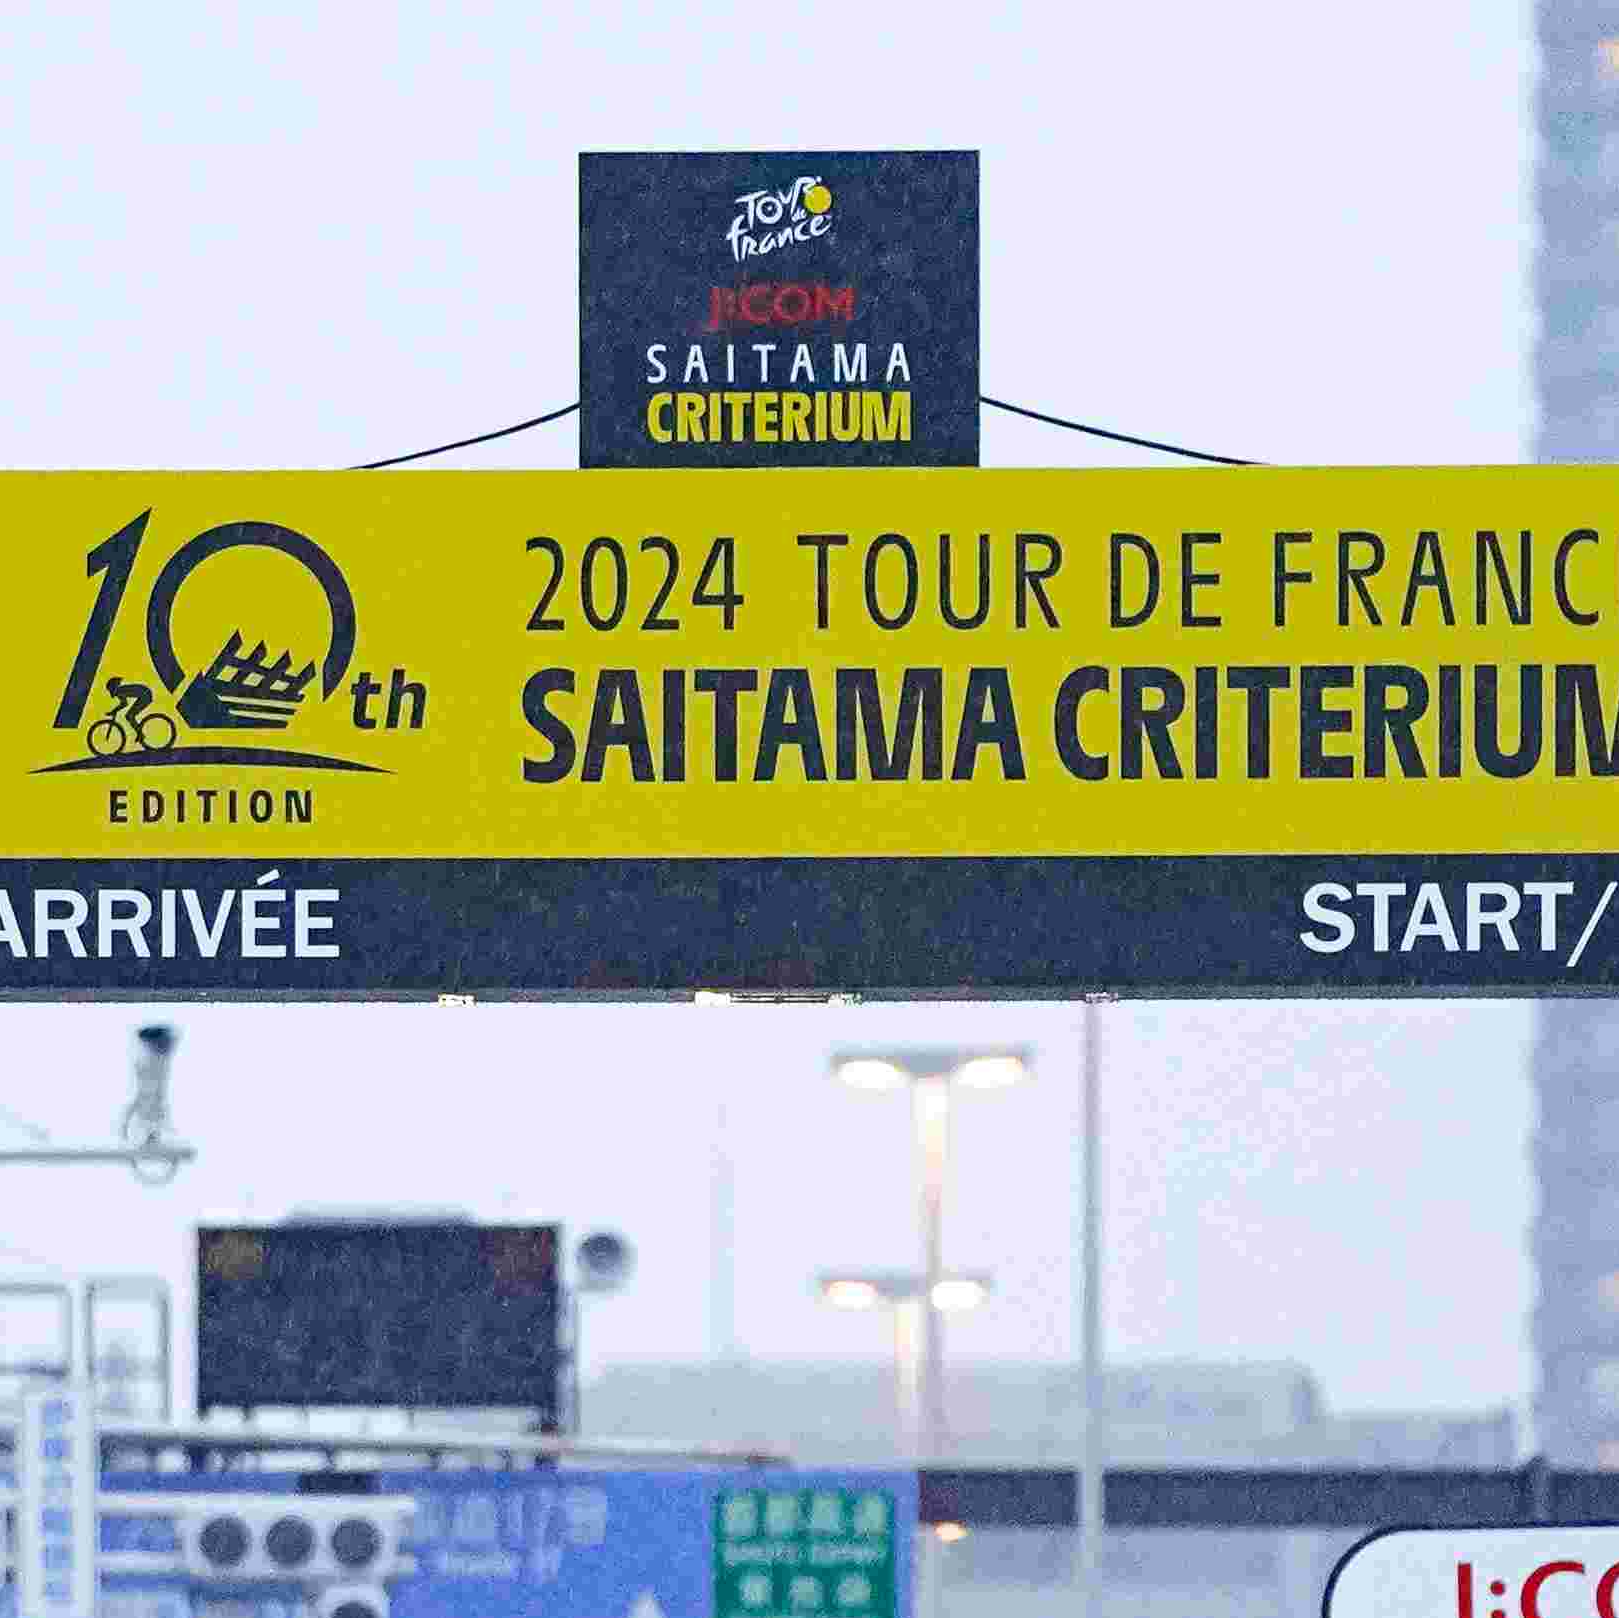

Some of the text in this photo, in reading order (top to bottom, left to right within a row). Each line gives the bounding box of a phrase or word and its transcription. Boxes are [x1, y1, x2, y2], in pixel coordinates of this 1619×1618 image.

[645, 343, 911, 384] SAITAMA
[645, 391, 912, 442] CRITERIUM
[524, 536, 745, 632] 2024
[801, 533, 1063, 632] TOUR
[1109, 532, 1223, 628] DE
[522, 666, 1026, 784] SAITAMA
[108, 790, 313, 824] EDITION
